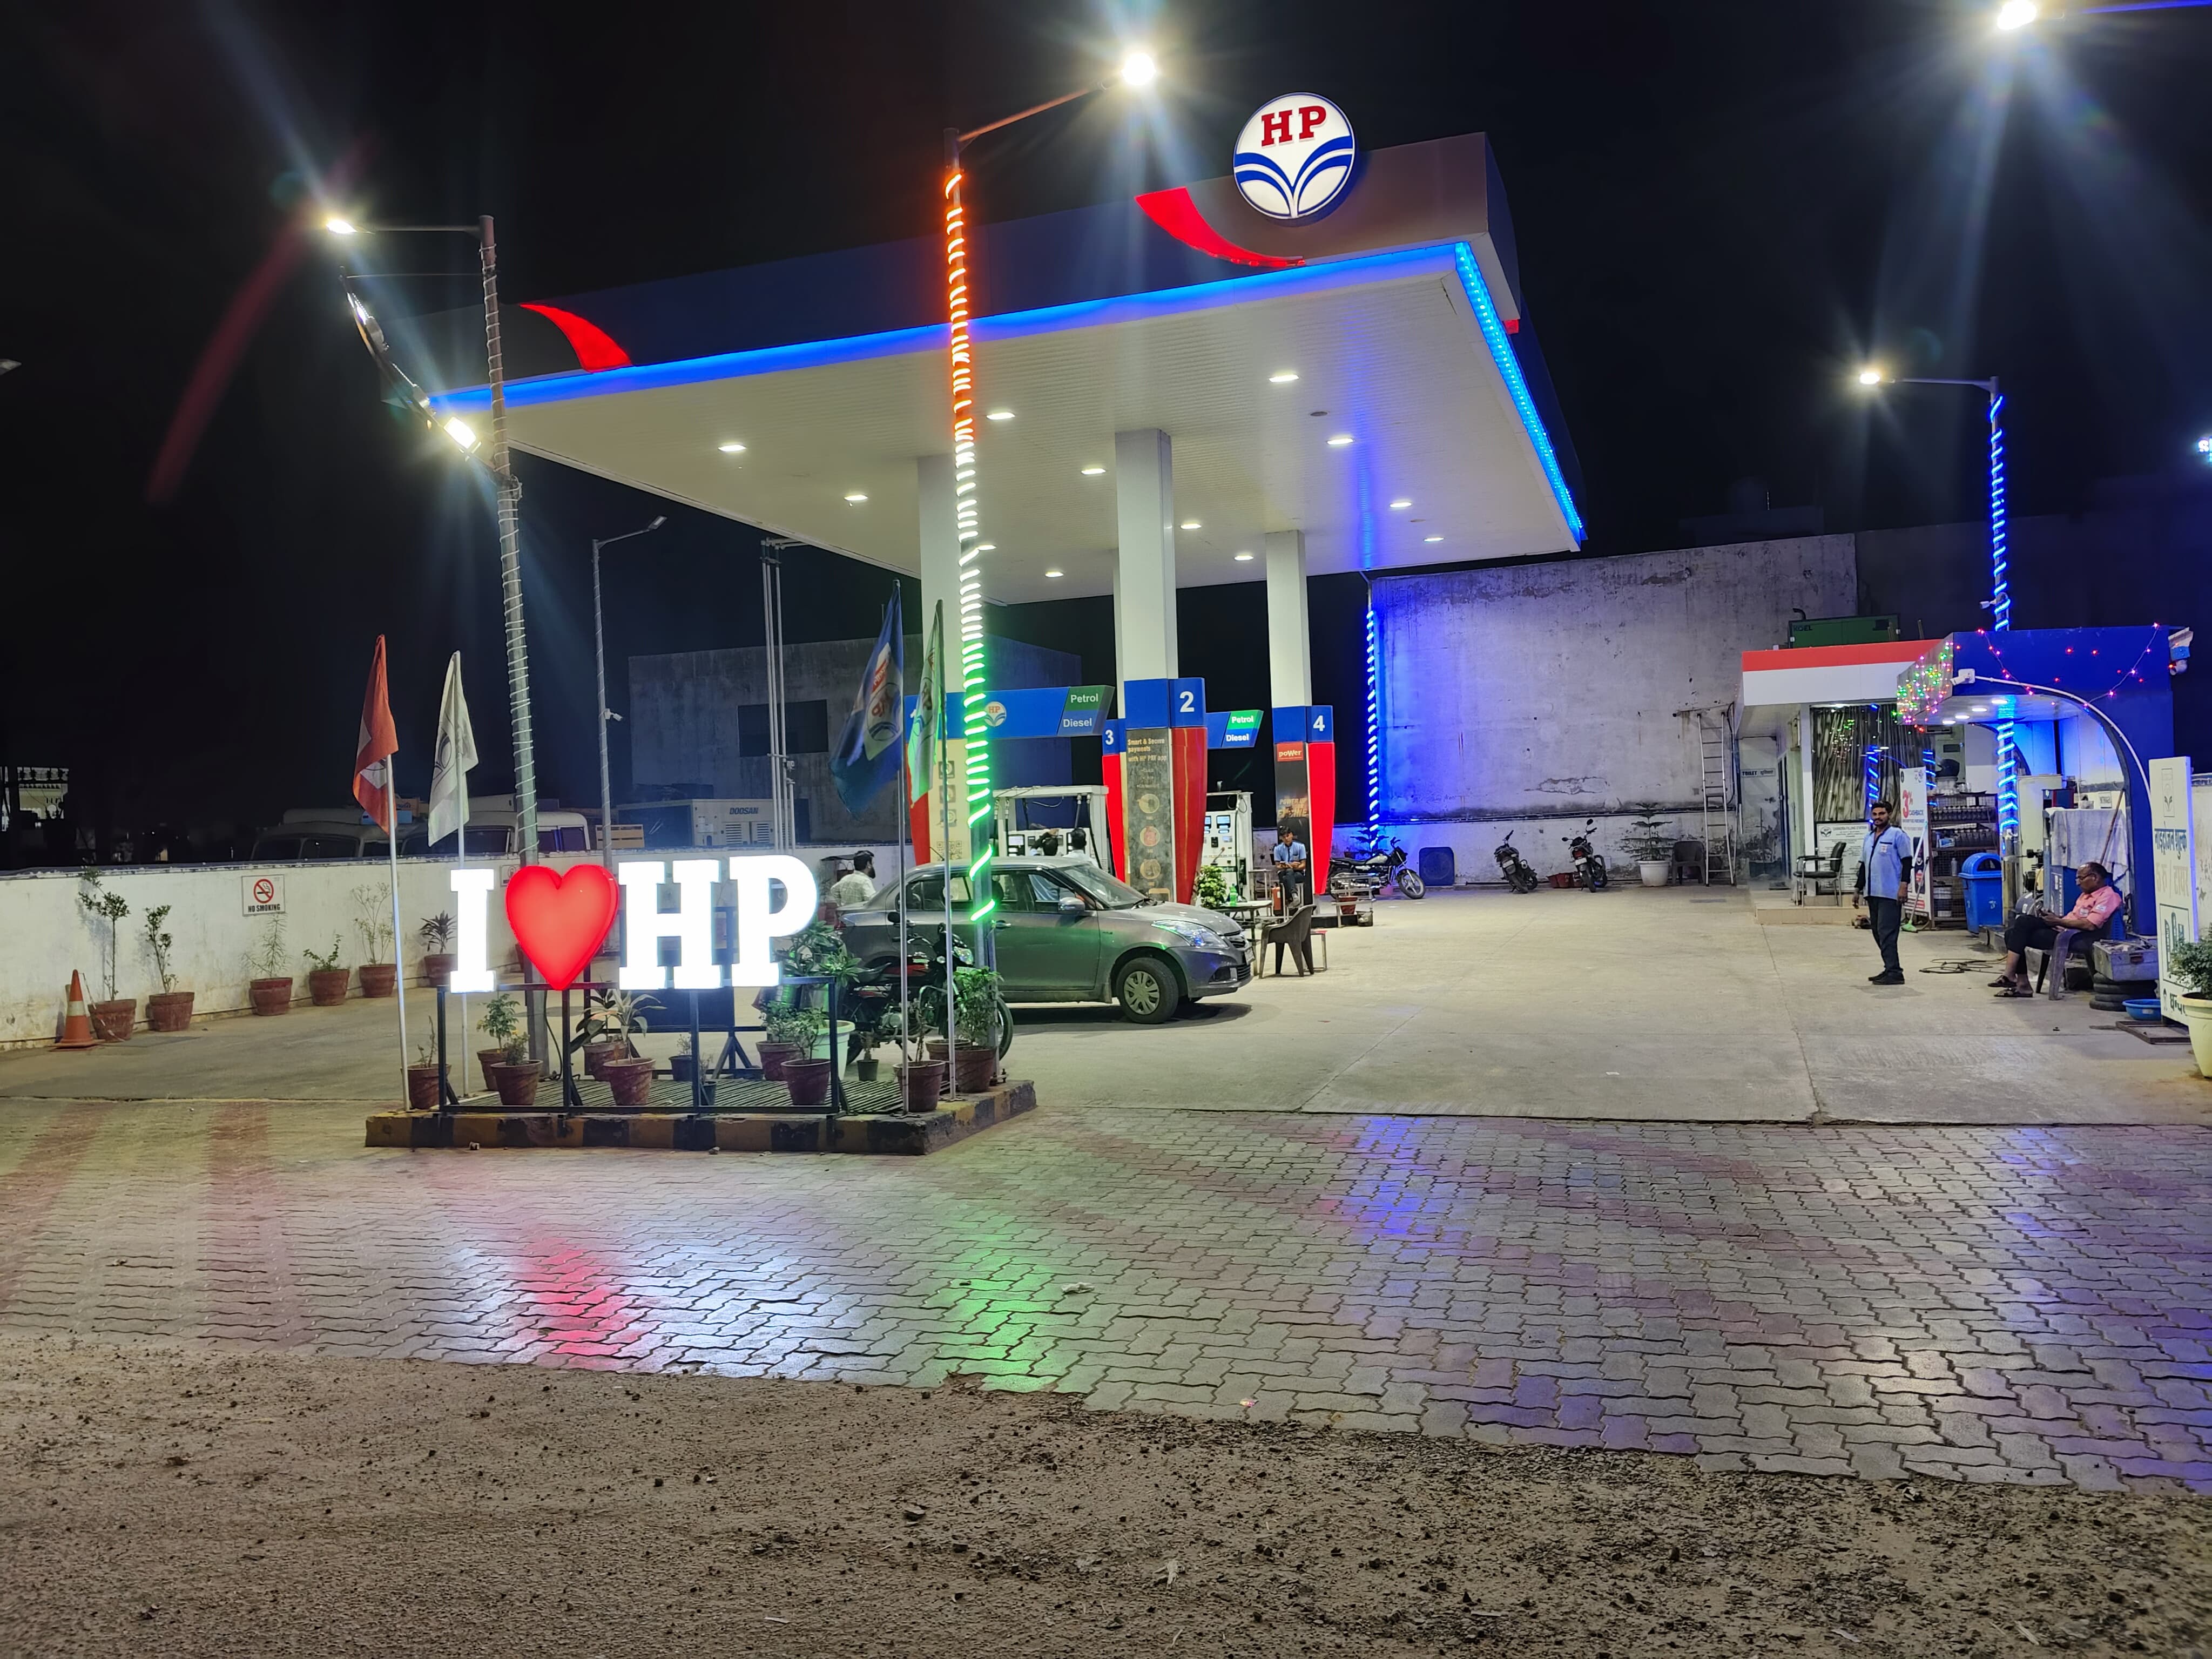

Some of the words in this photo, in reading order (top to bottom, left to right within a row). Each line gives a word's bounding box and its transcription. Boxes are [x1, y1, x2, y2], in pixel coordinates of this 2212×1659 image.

[1262, 105, 1326, 147] HP
[1070, 693, 1098, 703] Petrol
[1179, 691, 1195, 712] 2
[1063, 718, 1092, 727] Diesel
[1231, 716, 1254, 724] Petrol
[1313, 715, 1325, 732] 4
[1105, 730, 1114, 745] 3
[450, 868, 494, 993] I
[618, 855, 817, 990] HP
